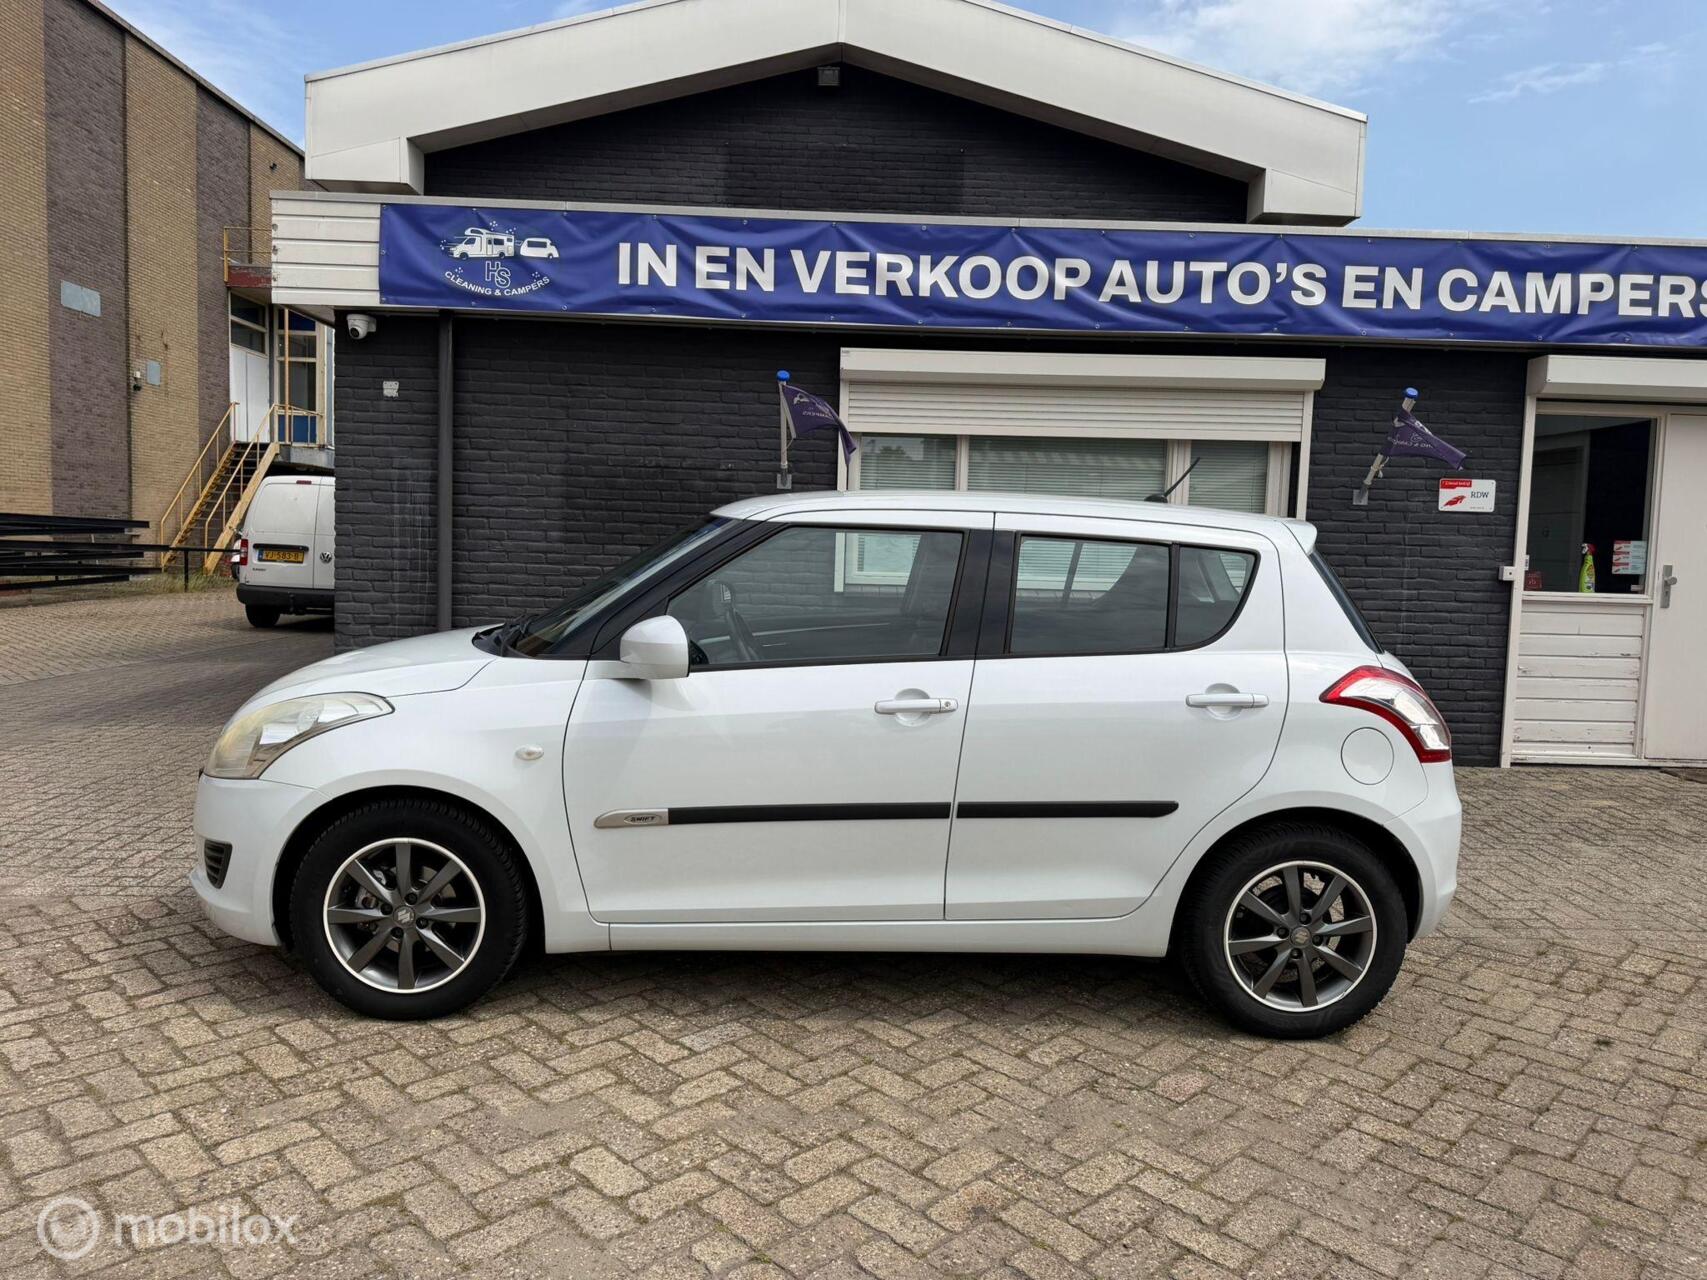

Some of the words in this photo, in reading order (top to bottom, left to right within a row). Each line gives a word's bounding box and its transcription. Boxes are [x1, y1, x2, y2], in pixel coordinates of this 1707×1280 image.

[444, 271, 492, 295] CLEANING
[494, 288, 502, 296] &
[504, 276, 550, 296] CAMPERS
[618, 242, 678, 288] IN
[695, 245, 775, 292] EN
[790, 249, 1092, 302] VERKOOP
[1098, 260, 1327, 306] AUTO'S
[1341, 265, 1424, 310] EN
[1438, 268, 1707, 319] CAMPER
[1470, 491, 1490, 499] RDW
